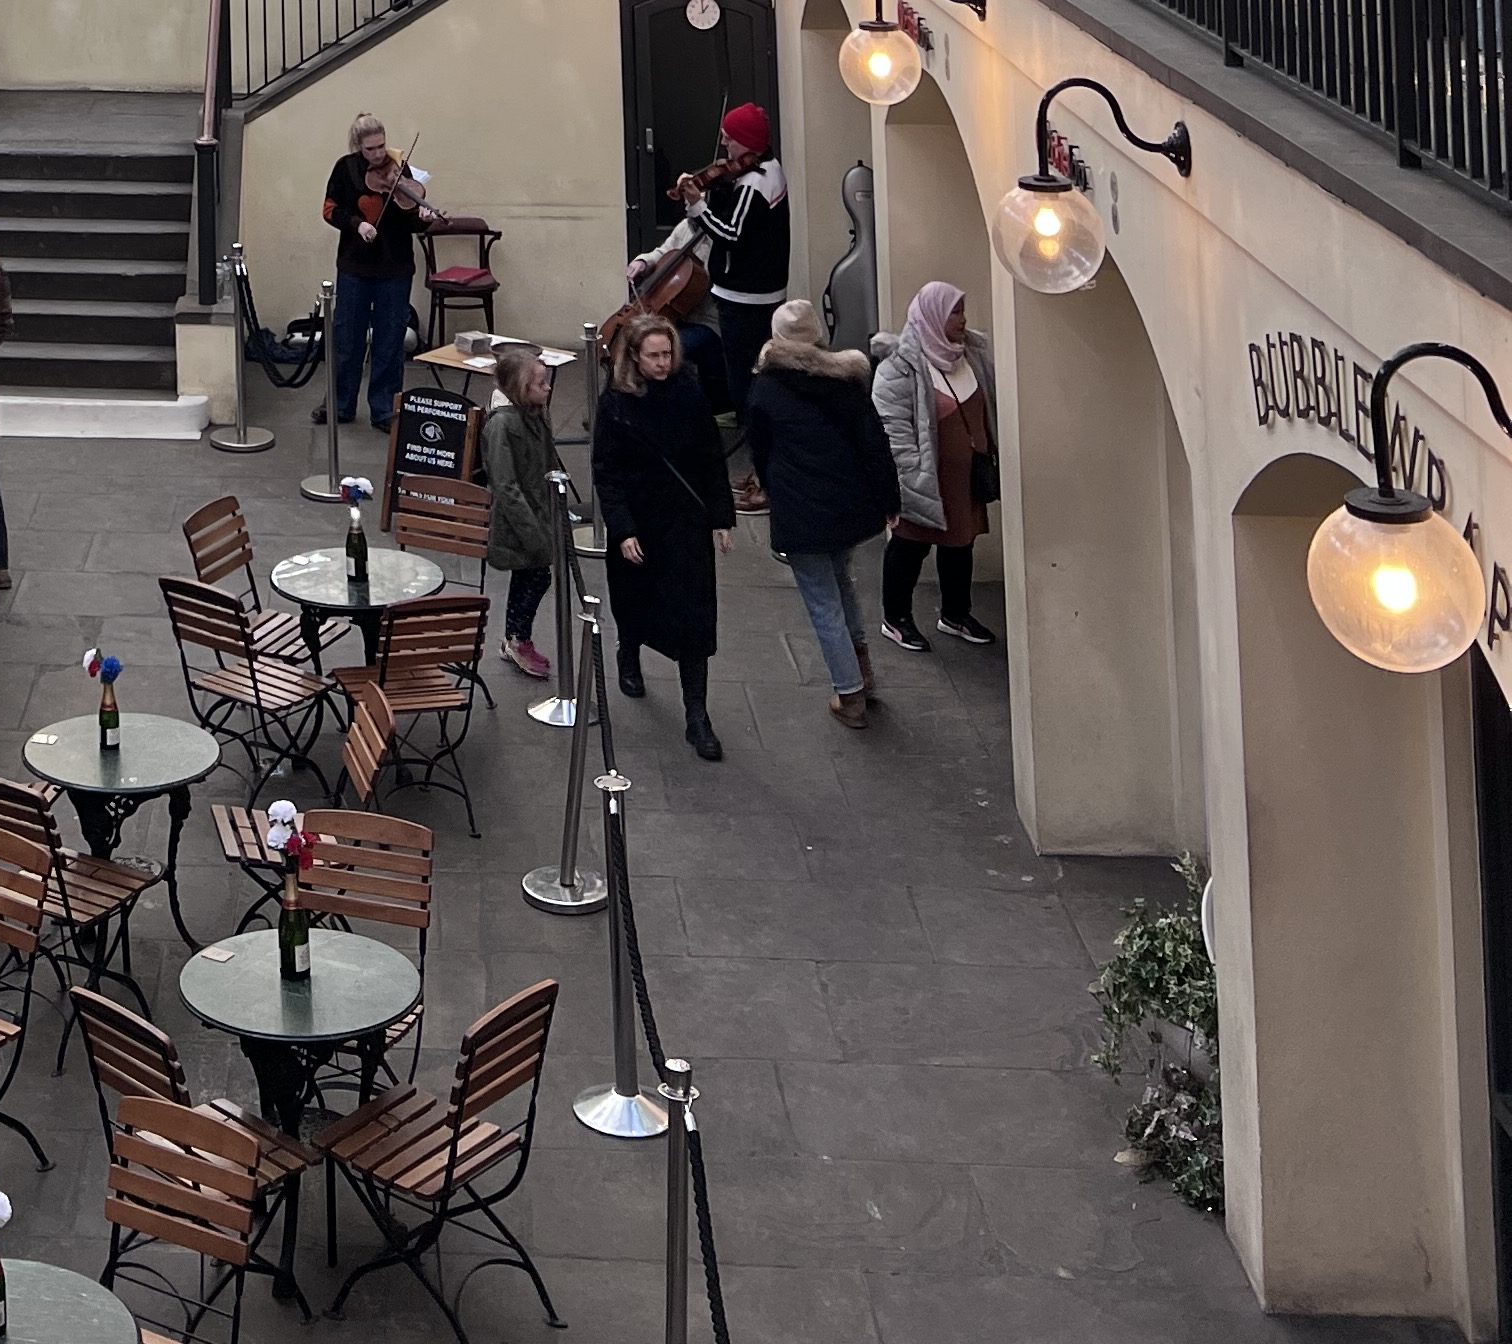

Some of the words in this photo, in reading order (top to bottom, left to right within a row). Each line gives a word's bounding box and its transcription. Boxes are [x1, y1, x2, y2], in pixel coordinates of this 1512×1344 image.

[409, 395, 433, 406] PLEASE
[433, 399, 463, 411] SUPPORT
[404, 402, 416, 412] THE
[417, 404, 467, 422] PERFORMANCES
[405, 452, 427, 463] ABOUT
[406, 443, 422, 453] FIND
[423, 446, 436, 455] OUT
[436, 449, 456, 460] MORE
